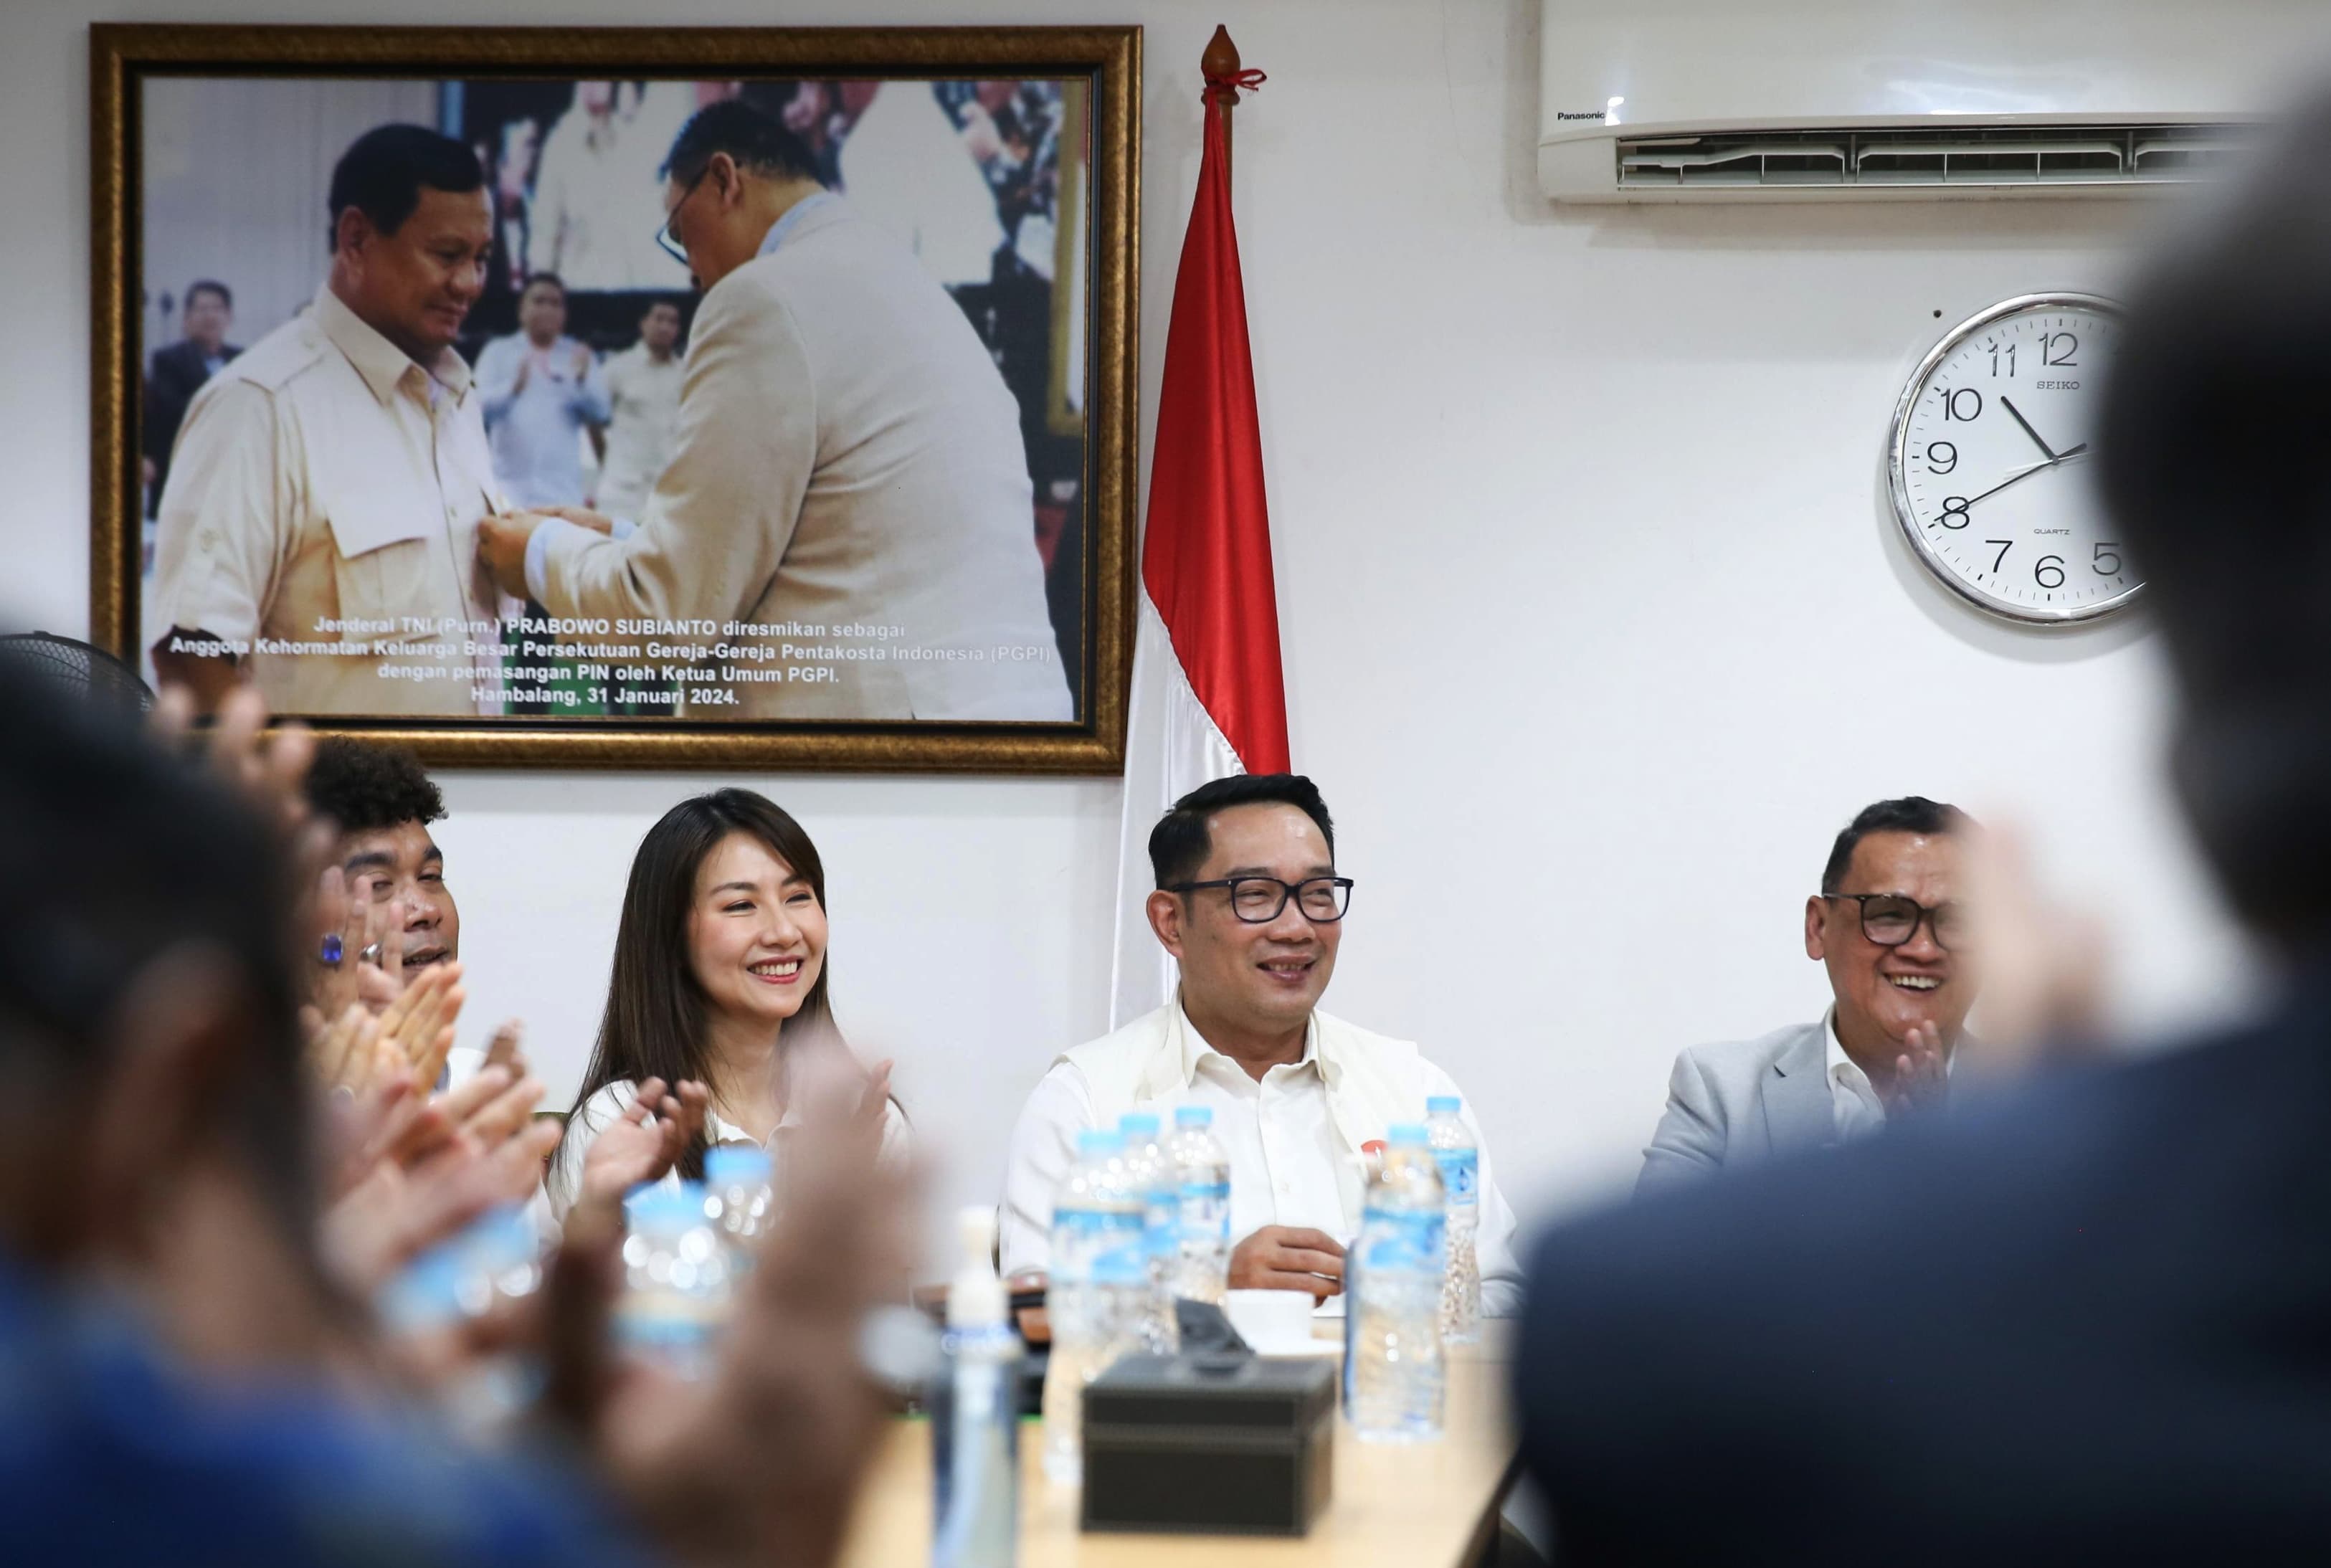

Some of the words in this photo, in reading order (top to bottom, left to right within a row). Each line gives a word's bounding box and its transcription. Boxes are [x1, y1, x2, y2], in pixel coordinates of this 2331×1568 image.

[1557, 111, 1605, 120] Panasonic
[1988, 343, 2016, 377] 11
[2038, 332, 2077, 366] 12
[2036, 381, 2080, 390] SEIKO
[1940, 388, 1983, 421] 10
[1927, 441, 1957, 474] 9
[1940, 496, 1970, 529] 8
[1985, 540, 2013, 574] 7
[2035, 555, 2065, 588] 6
[2092, 543, 2121, 576] 5
[313, 617, 394, 633] Jenderal
[402, 617, 432, 633] TNI
[438, 617, 500, 635] (Purn.)
[507, 618, 609, 634] PRABOWO
[615, 619, 716, 636] SUBIANTO
[722, 620, 826, 637] diresmikan
[832, 622, 906, 640] sebagai
[170, 637, 249, 657] Anggota
[255, 638, 369, 655] Kehormatan
[374, 639, 457, 659] Keluarga
[464, 640, 518, 657] Besar
[523, 642, 640, 658] Persekutuan
[646, 643, 776, 661] Gereja-Gereja
[782, 645, 886, 660] Pentakosta
[893, 645, 984, 661] Indonesia
[990, 645, 1050, 663] (PGPI)
[378, 663, 446, 682] dengan
[452, 663, 571, 682] pemasangan
[578, 665, 609, 680] PIN
[615, 665, 655, 681] oleh
[662, 665, 715, 682] Ketua
[722, 667, 782, 682] Umum
[788, 667, 840, 683] PGPI.
[471, 688, 581, 705] Hambalang,
[587, 688, 608, 703] 31
[614, 688, 683, 704] Januari
[690, 689, 739, 705] 2024.
